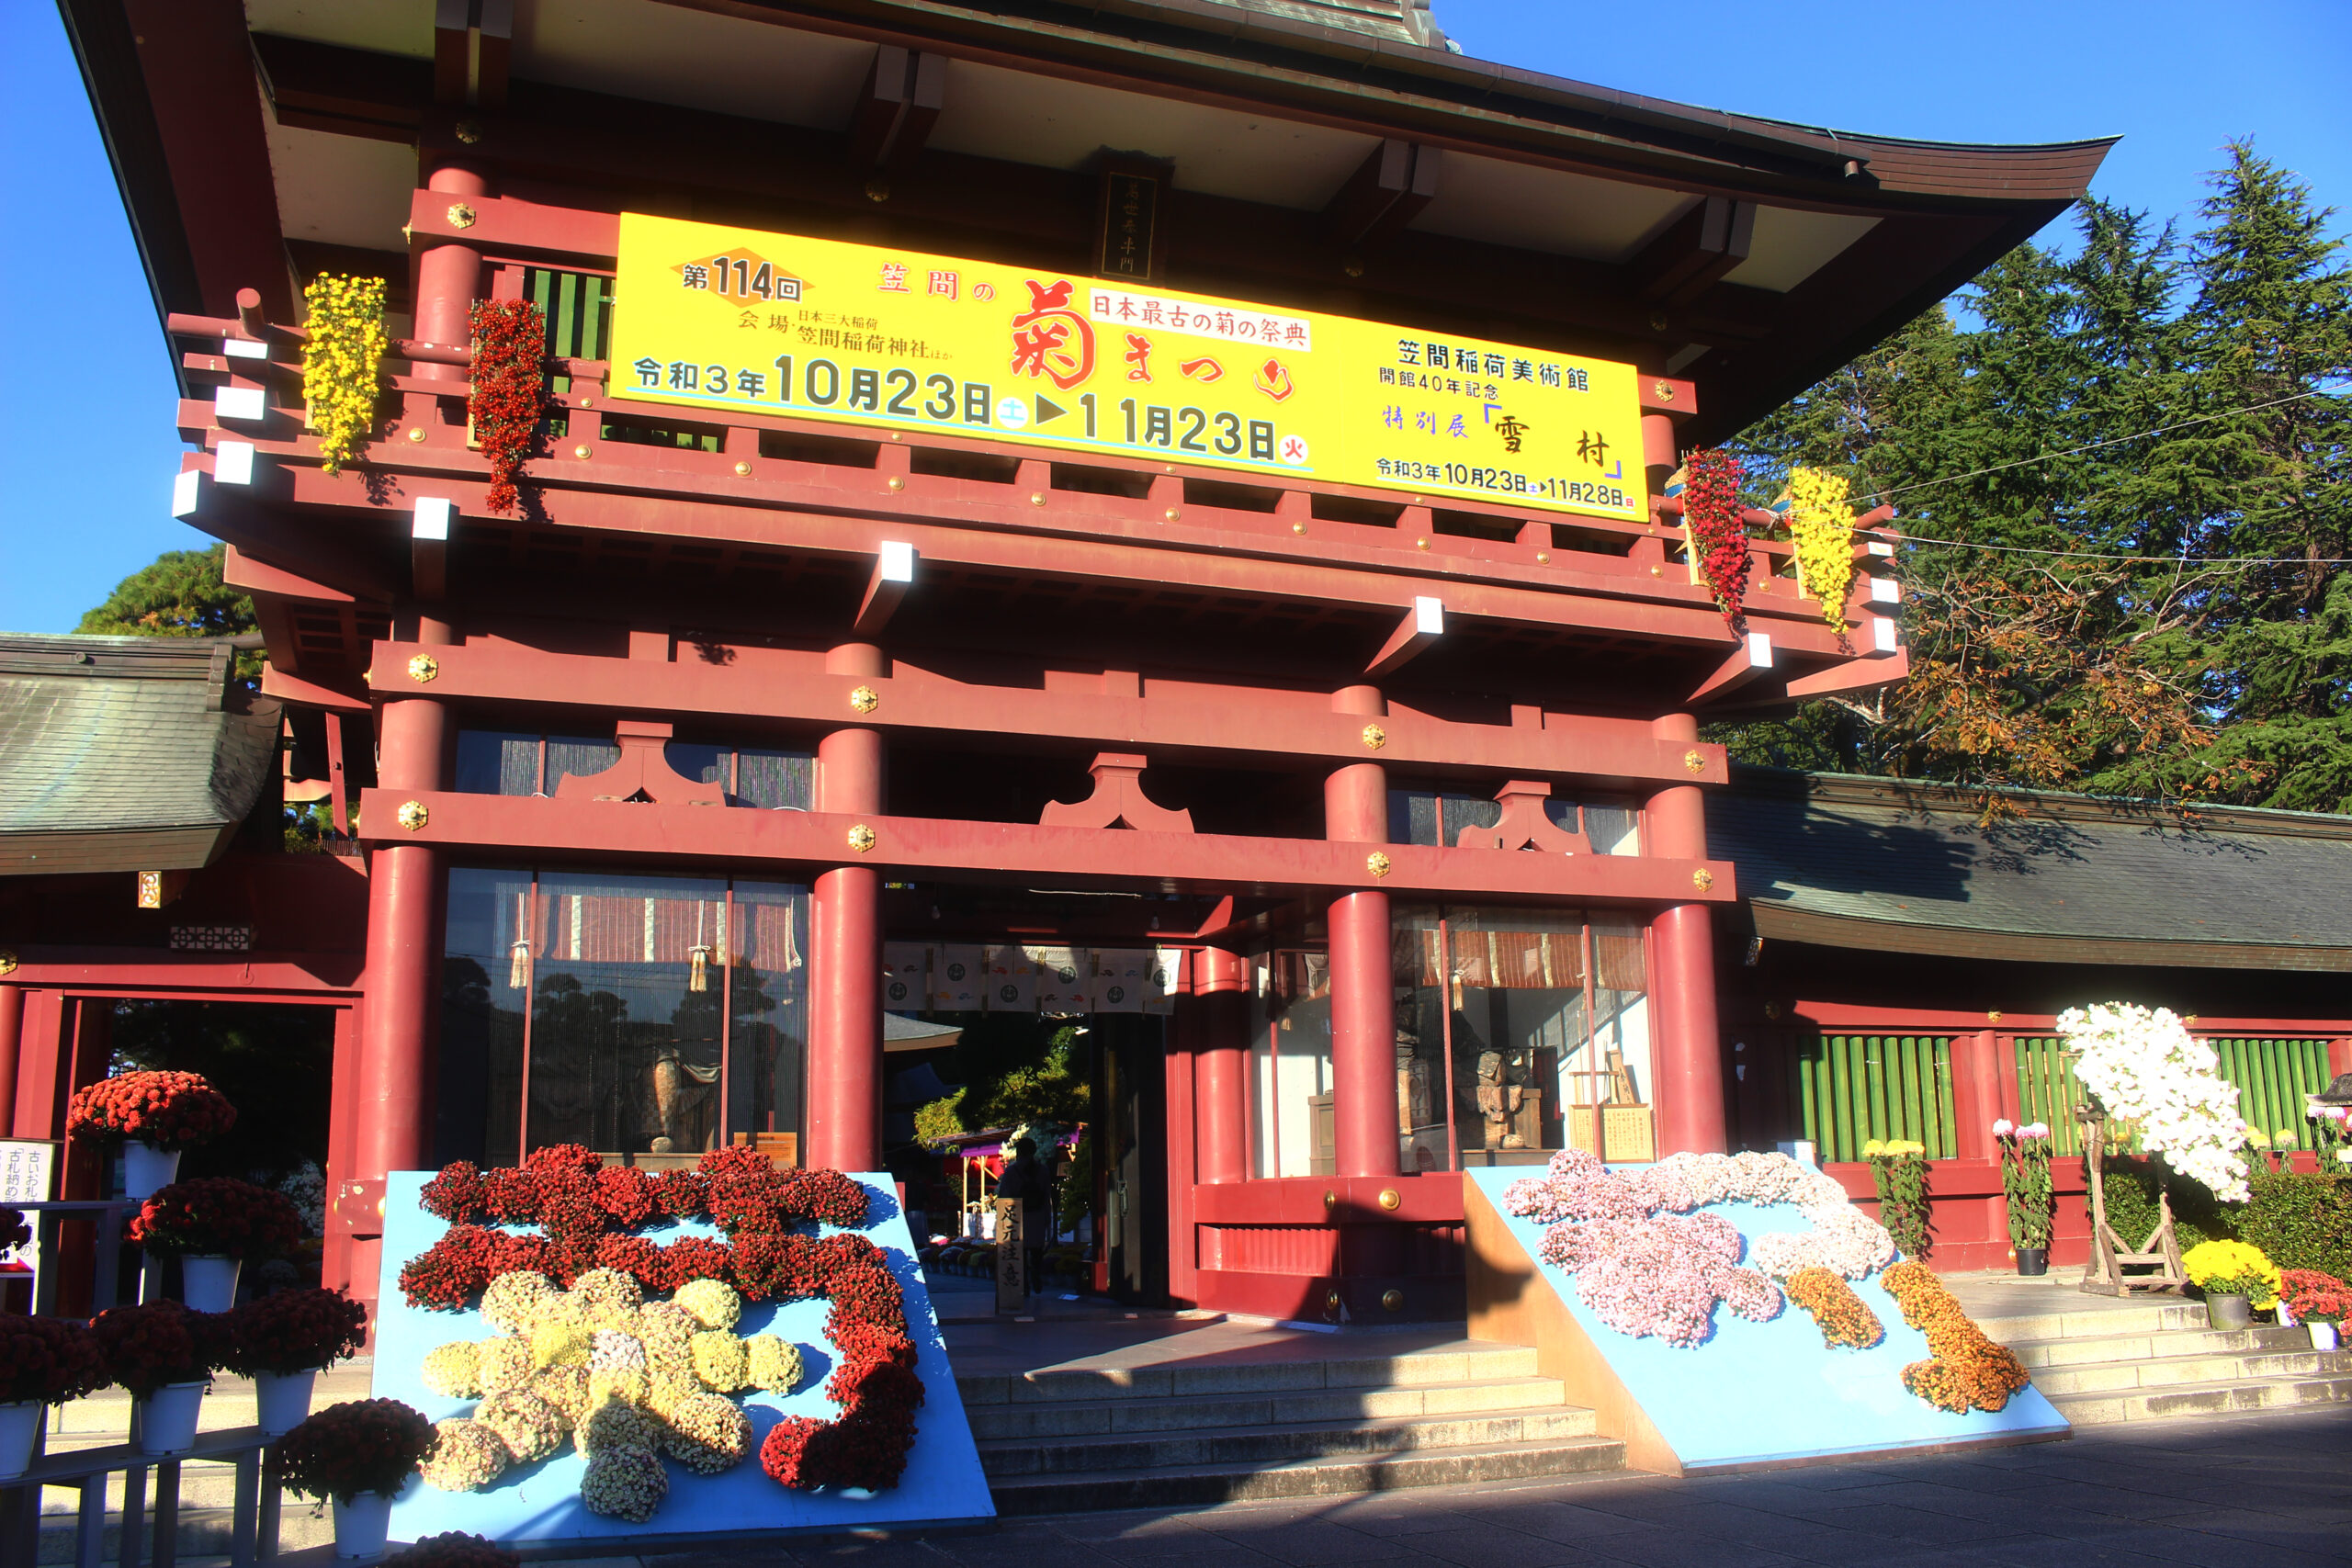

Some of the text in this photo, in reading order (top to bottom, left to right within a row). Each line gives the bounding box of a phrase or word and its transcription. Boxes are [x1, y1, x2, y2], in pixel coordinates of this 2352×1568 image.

[684, 256, 801, 302] 第114回
[878, 263, 995, 302] 笠間の
[799, 309, 877, 332] 日本三大稲荷
[1094, 296, 1306, 346] 日本最古の菊の祭典
[1380, 368, 1498, 400] 開館40年記念
[1398, 339, 1588, 392] 笠間稲荷美術館
[1382, 405, 1469, 438] 特別展
[1001, 1205, 1020, 1287] 足元注意
